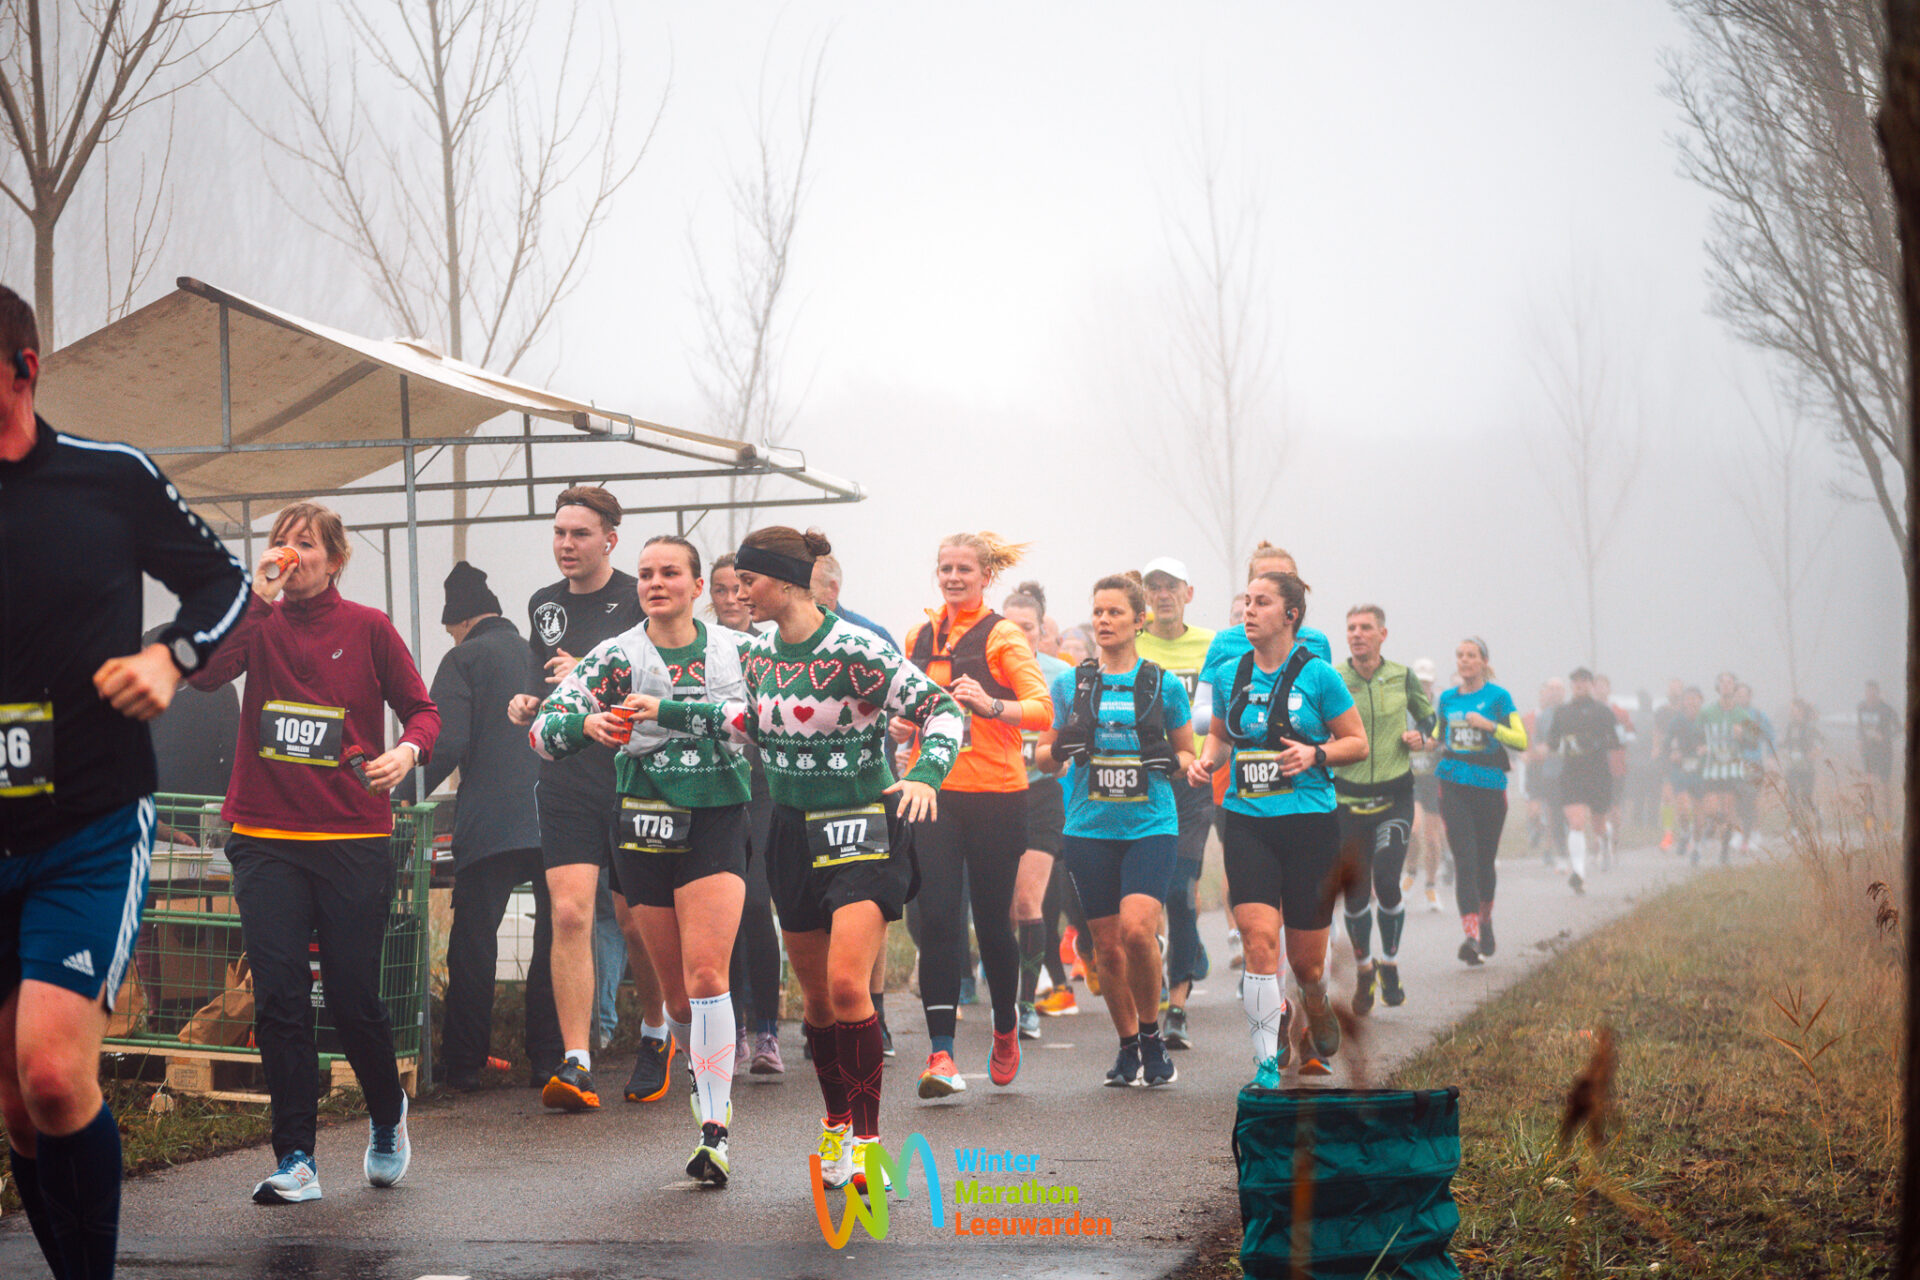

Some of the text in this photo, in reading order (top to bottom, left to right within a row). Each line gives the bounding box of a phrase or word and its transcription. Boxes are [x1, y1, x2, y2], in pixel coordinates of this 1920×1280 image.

[275, 717, 328, 746] 1097
[1096, 768, 1138, 788] 1083
[1242, 762, 1280, 783] 1082
[632, 814, 674, 839] 1776
[823, 818, 868, 847] 1777
